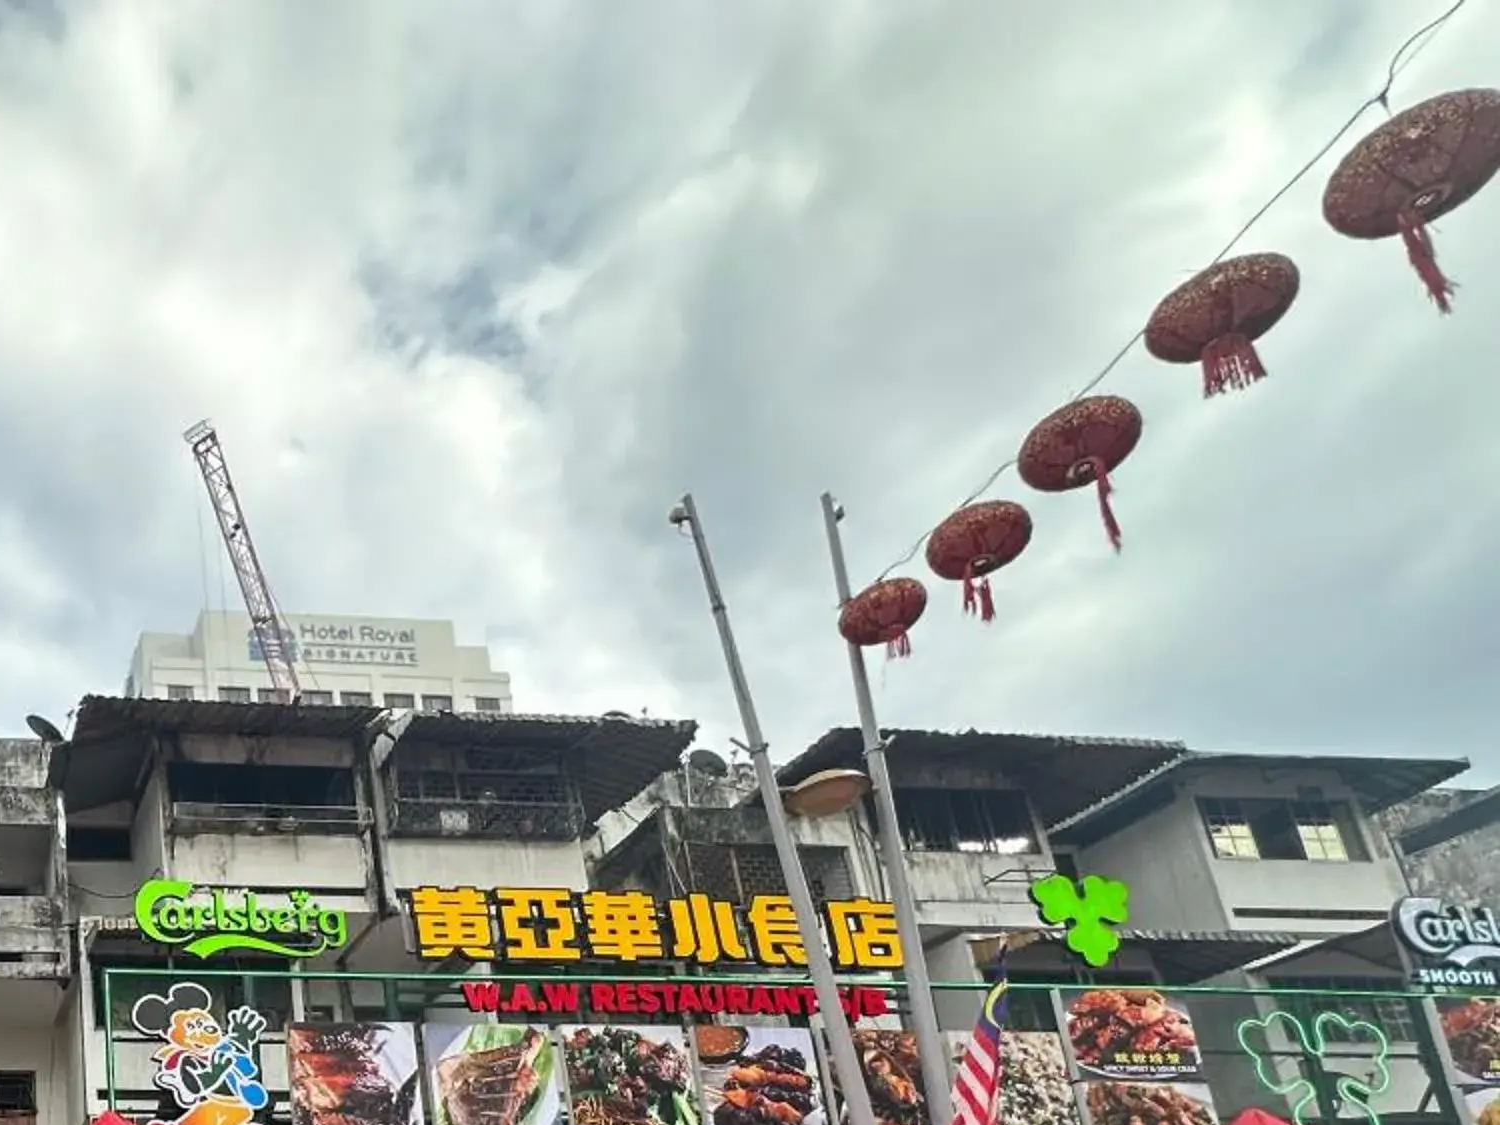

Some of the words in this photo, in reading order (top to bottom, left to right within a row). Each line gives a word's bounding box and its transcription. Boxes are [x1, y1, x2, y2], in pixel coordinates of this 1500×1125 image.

[299, 623, 354, 642] Hotel
[359, 625, 415, 644] Royal
[135, 879, 349, 949] Carlsberg
[1418, 968, 1497, 986] SMOOTH
[461, 980, 579, 1013] W.A.W
[589, 982, 819, 1016] RESTAURANT
